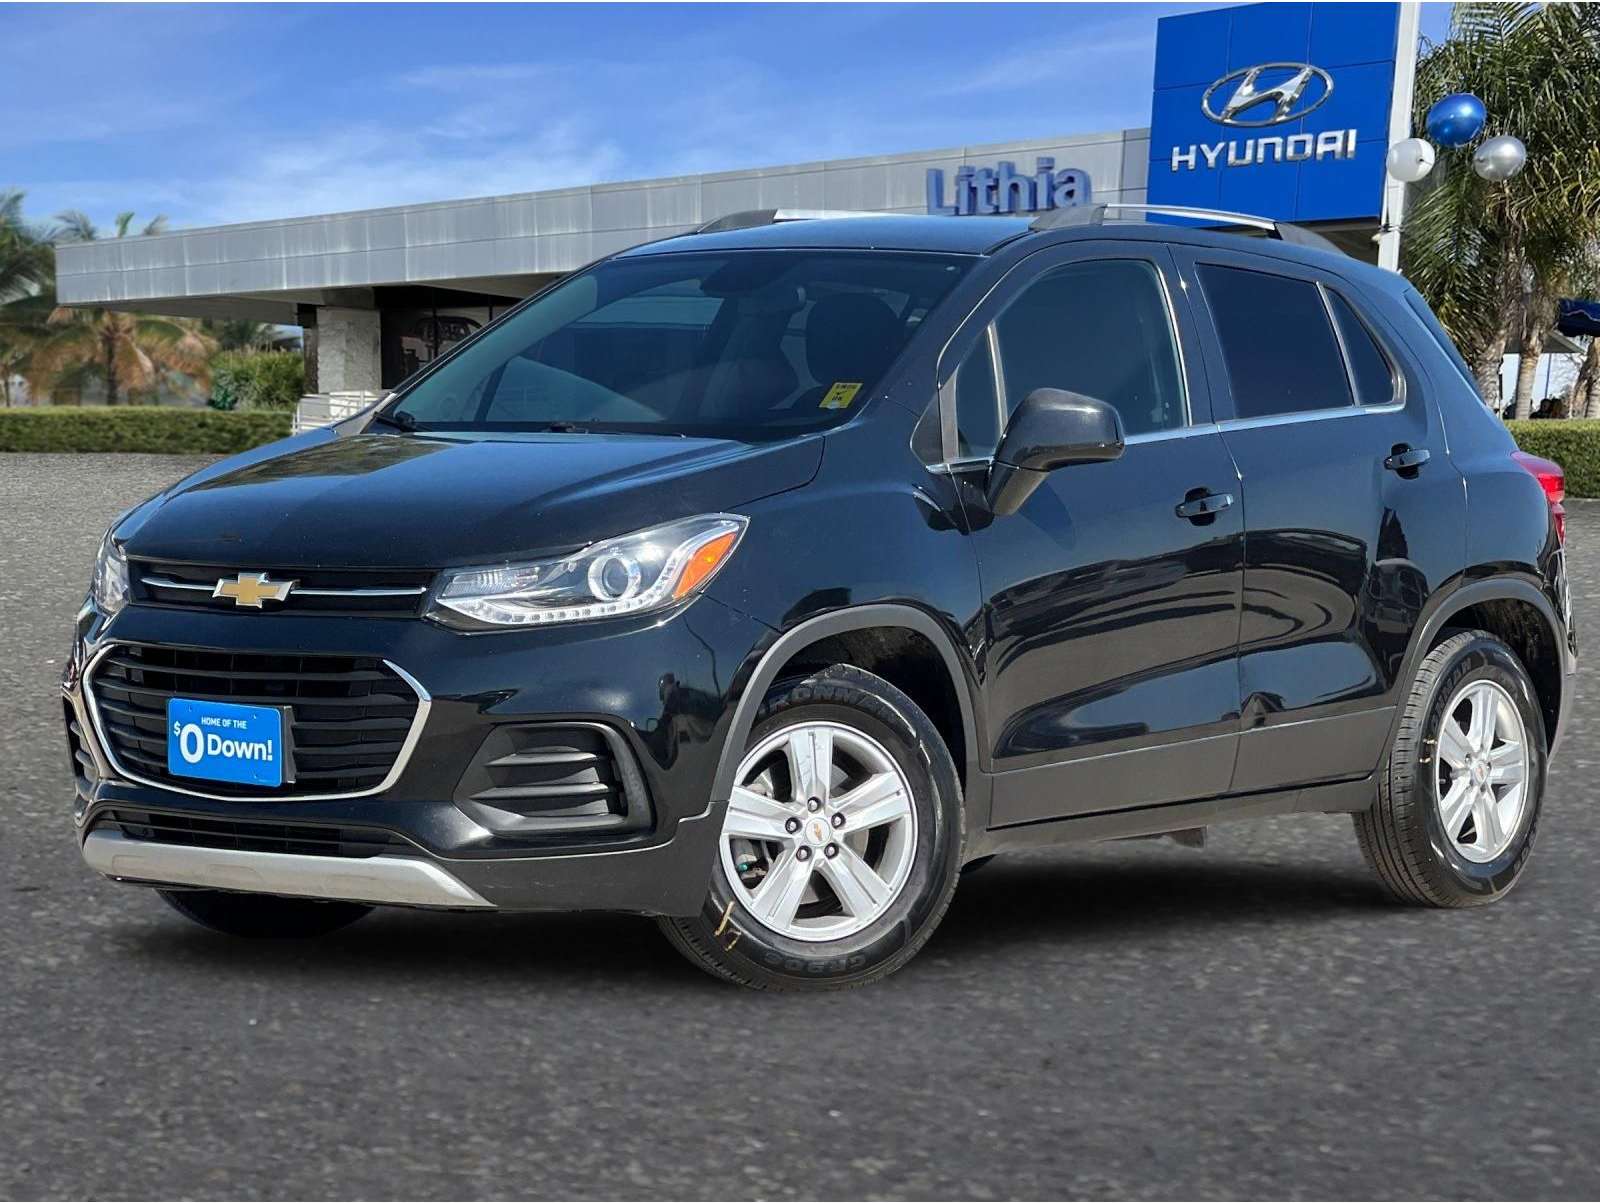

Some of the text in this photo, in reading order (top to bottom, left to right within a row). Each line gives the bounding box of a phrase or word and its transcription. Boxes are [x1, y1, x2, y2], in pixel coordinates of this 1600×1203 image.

[1171, 129, 1357, 171] HYUNDAI
[926, 156, 1091, 216] Lithia
[201, 716, 247, 729] HOME OF THE
[207, 734, 272, 761] Down!
